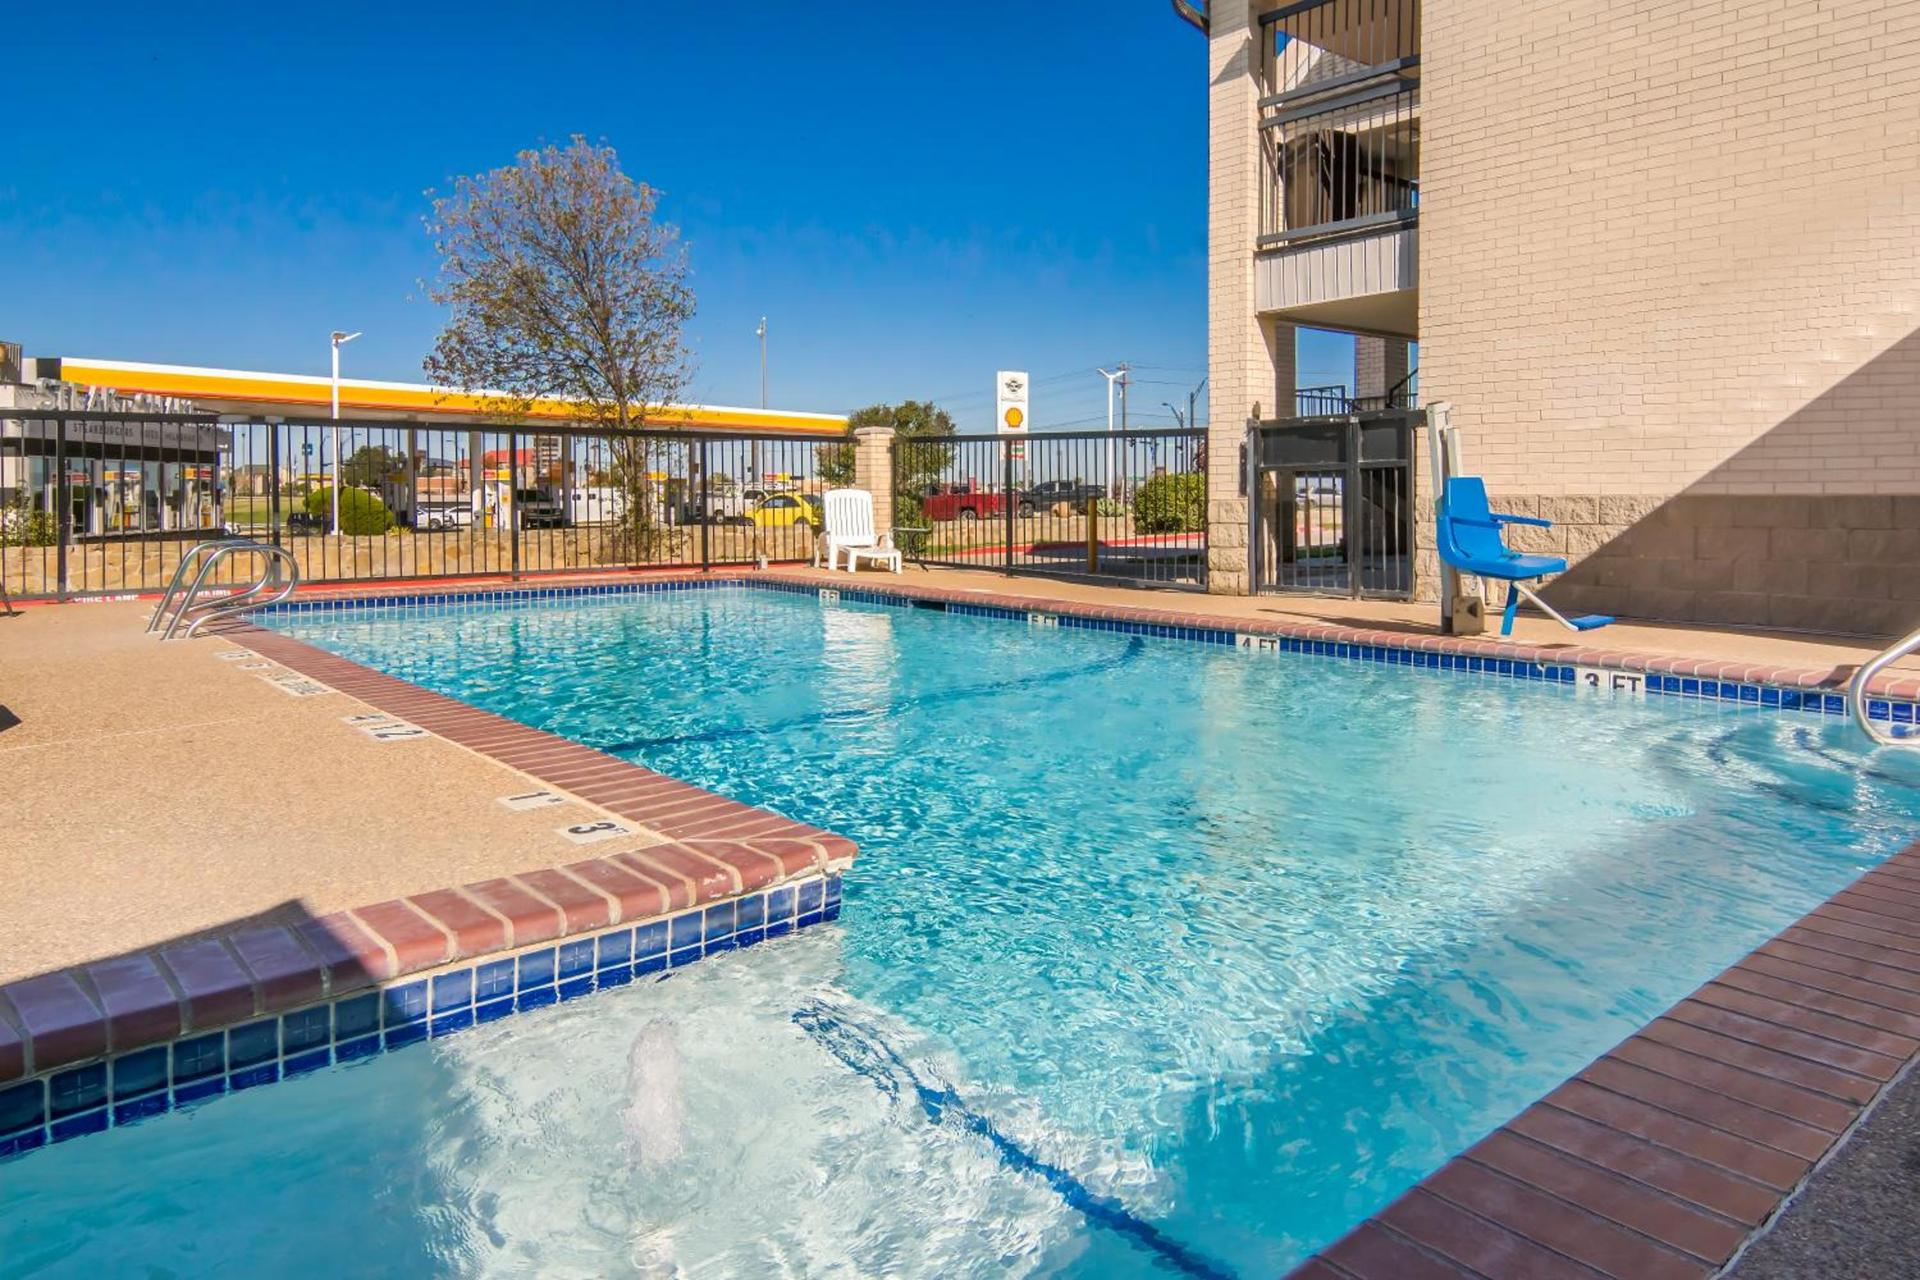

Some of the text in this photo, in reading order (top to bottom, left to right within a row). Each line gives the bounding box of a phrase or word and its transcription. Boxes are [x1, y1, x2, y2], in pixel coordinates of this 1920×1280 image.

[1259, 638, 1277, 650] FT
[1584, 672, 1642, 692] 3 FT
[567, 822, 617, 835] 3
